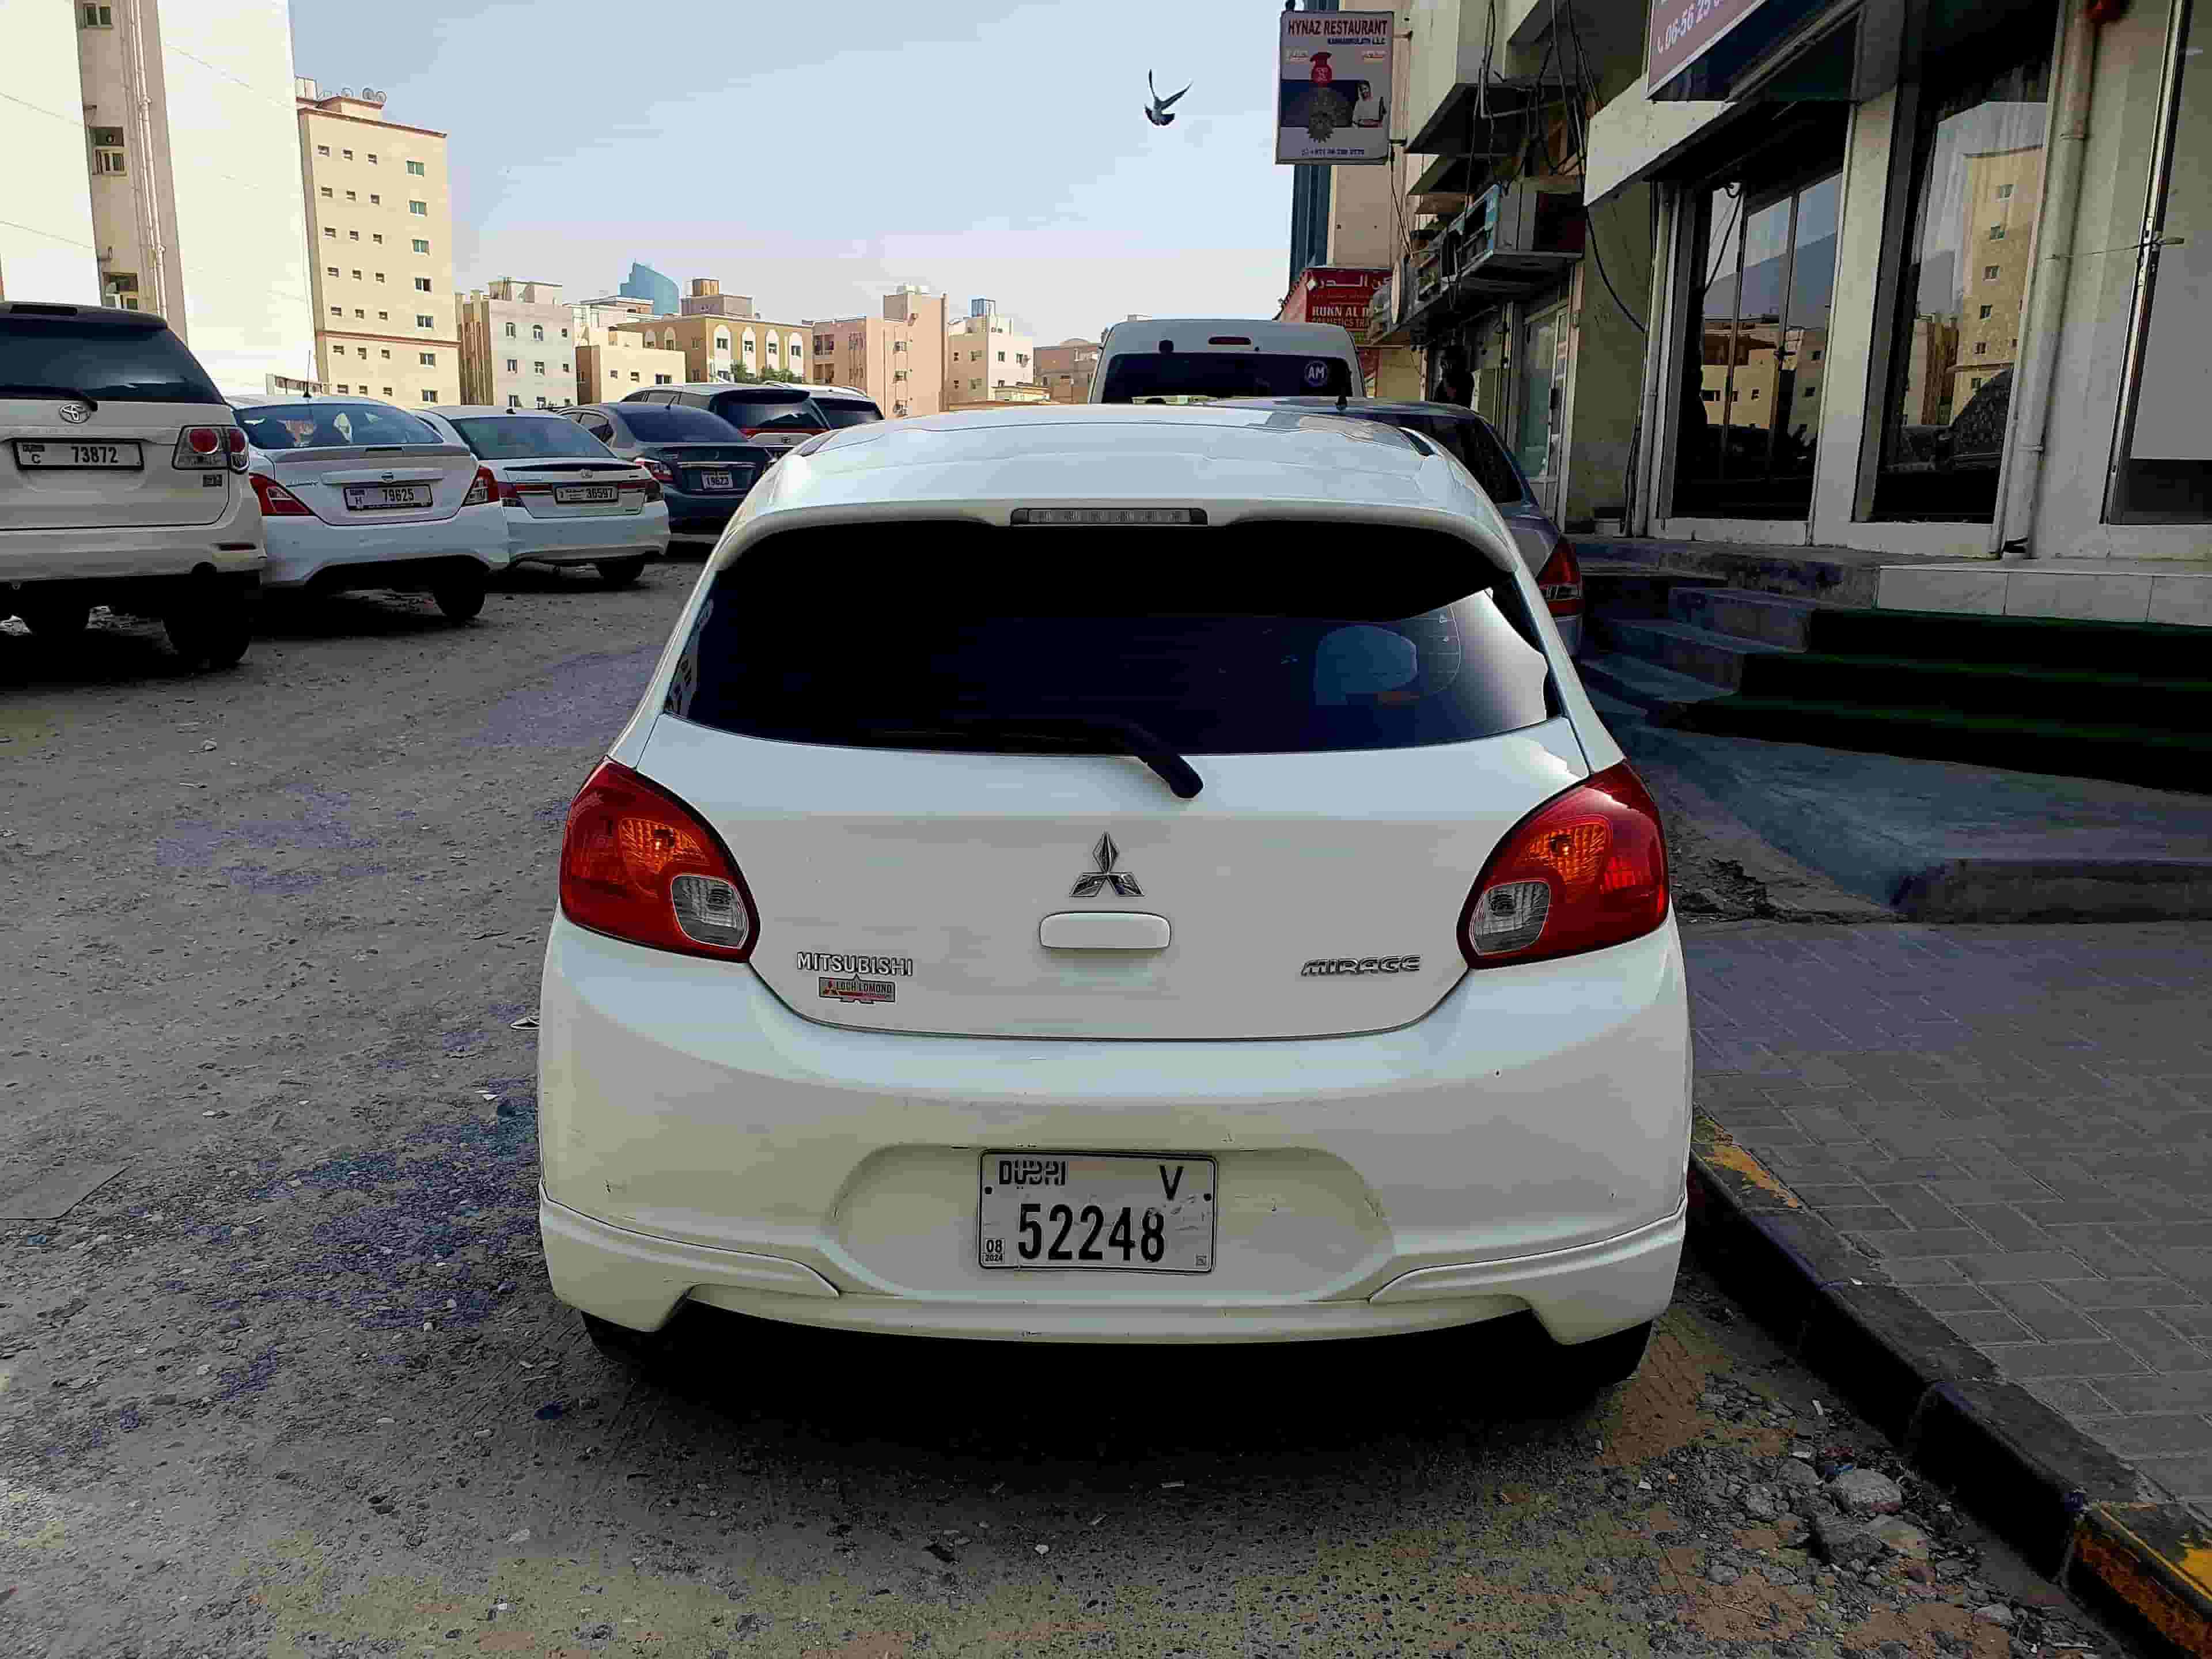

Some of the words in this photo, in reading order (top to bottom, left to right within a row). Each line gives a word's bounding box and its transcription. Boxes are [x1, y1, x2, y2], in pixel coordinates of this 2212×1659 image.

[1289, 20, 1321, 35] HYNAZ
[1324, 20, 1388, 35] RESTAURANT
[1312, 305, 1342, 317] RUKN
[1344, 306, 1359, 317] AL
[1308, 367, 1324, 378] AM
[31, 453, 41, 464] C
[71, 446, 119, 463] 73872
[381, 488, 415, 503] 79625
[585, 487, 615, 499] 36597
[797, 951, 913, 977] MITSUBISHI
[1300, 954, 1421, 977] MIRAGE
[1159, 1165, 1184, 1201] V
[1018, 1203, 1165, 1263] 52248
[986, 1239, 1003, 1253] 08
